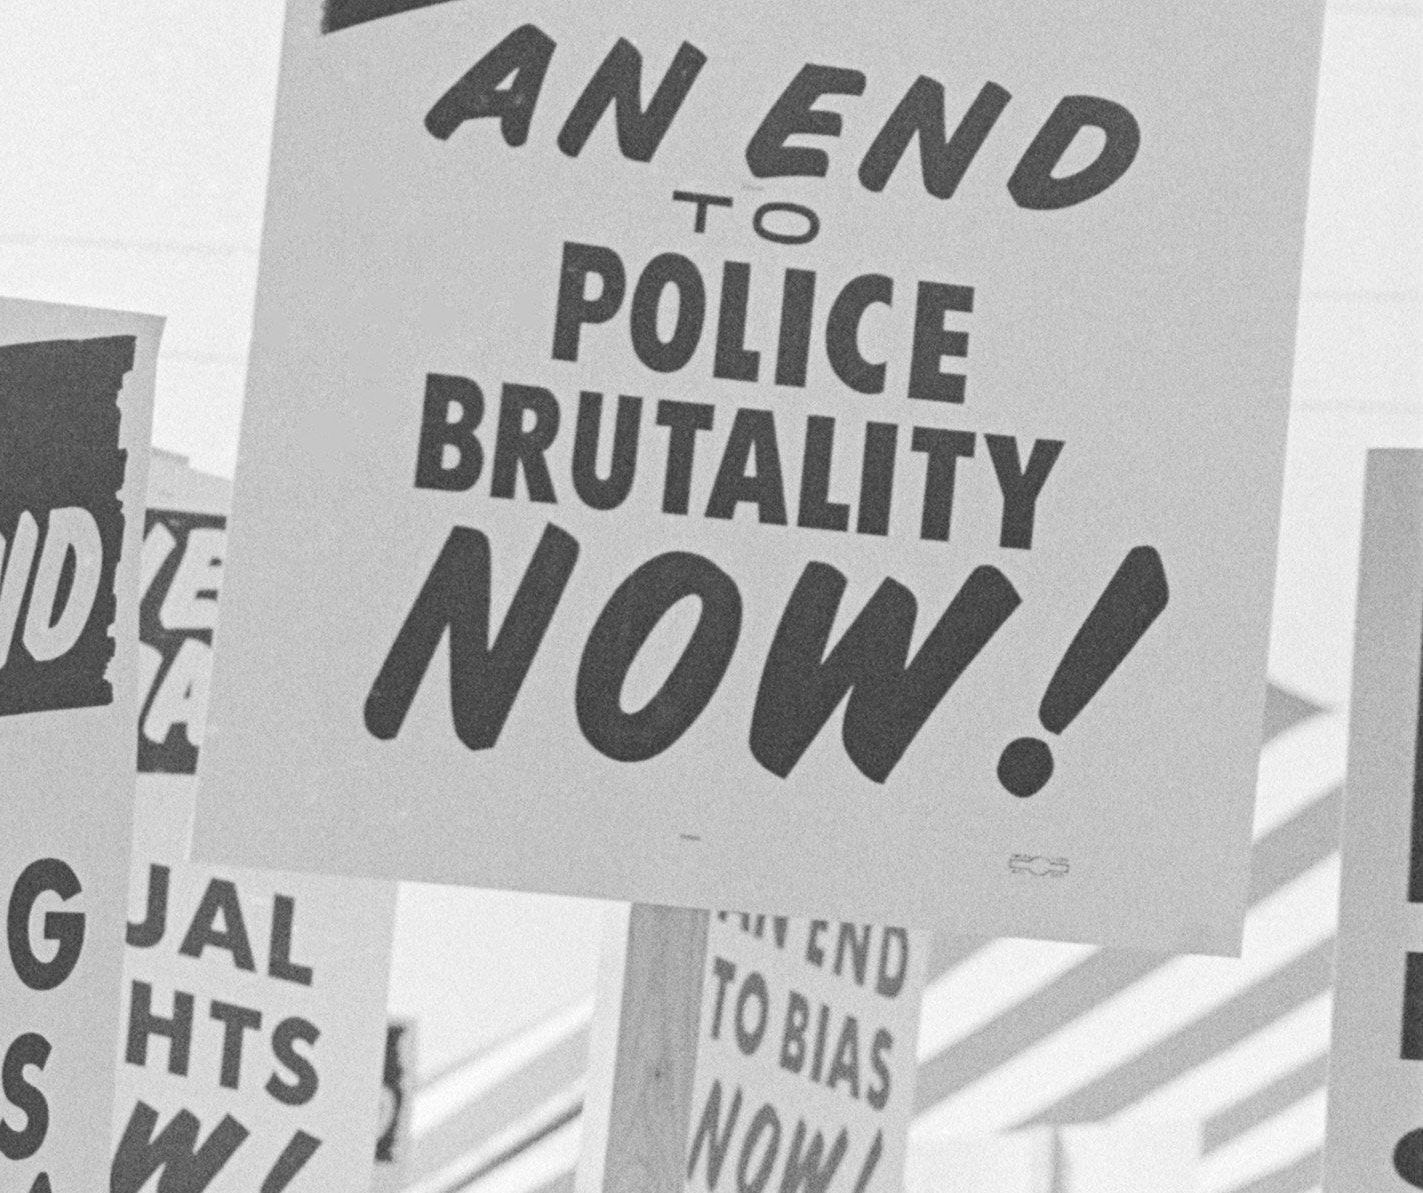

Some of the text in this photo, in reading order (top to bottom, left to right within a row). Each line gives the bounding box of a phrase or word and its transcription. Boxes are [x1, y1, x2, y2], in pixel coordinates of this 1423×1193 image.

[424, 23, 1142, 211] AN END
[673, 190, 822, 246] TO
[552, 241, 976, 404] POLICE
[414, 372, 1067, 552] BRUTALITY
[363, 522, 1170, 800] NOW!
[710, 955, 894, 1112] TO BIAS
[805, 919, 909, 998] END
[125, 978, 321, 1106] HTS
